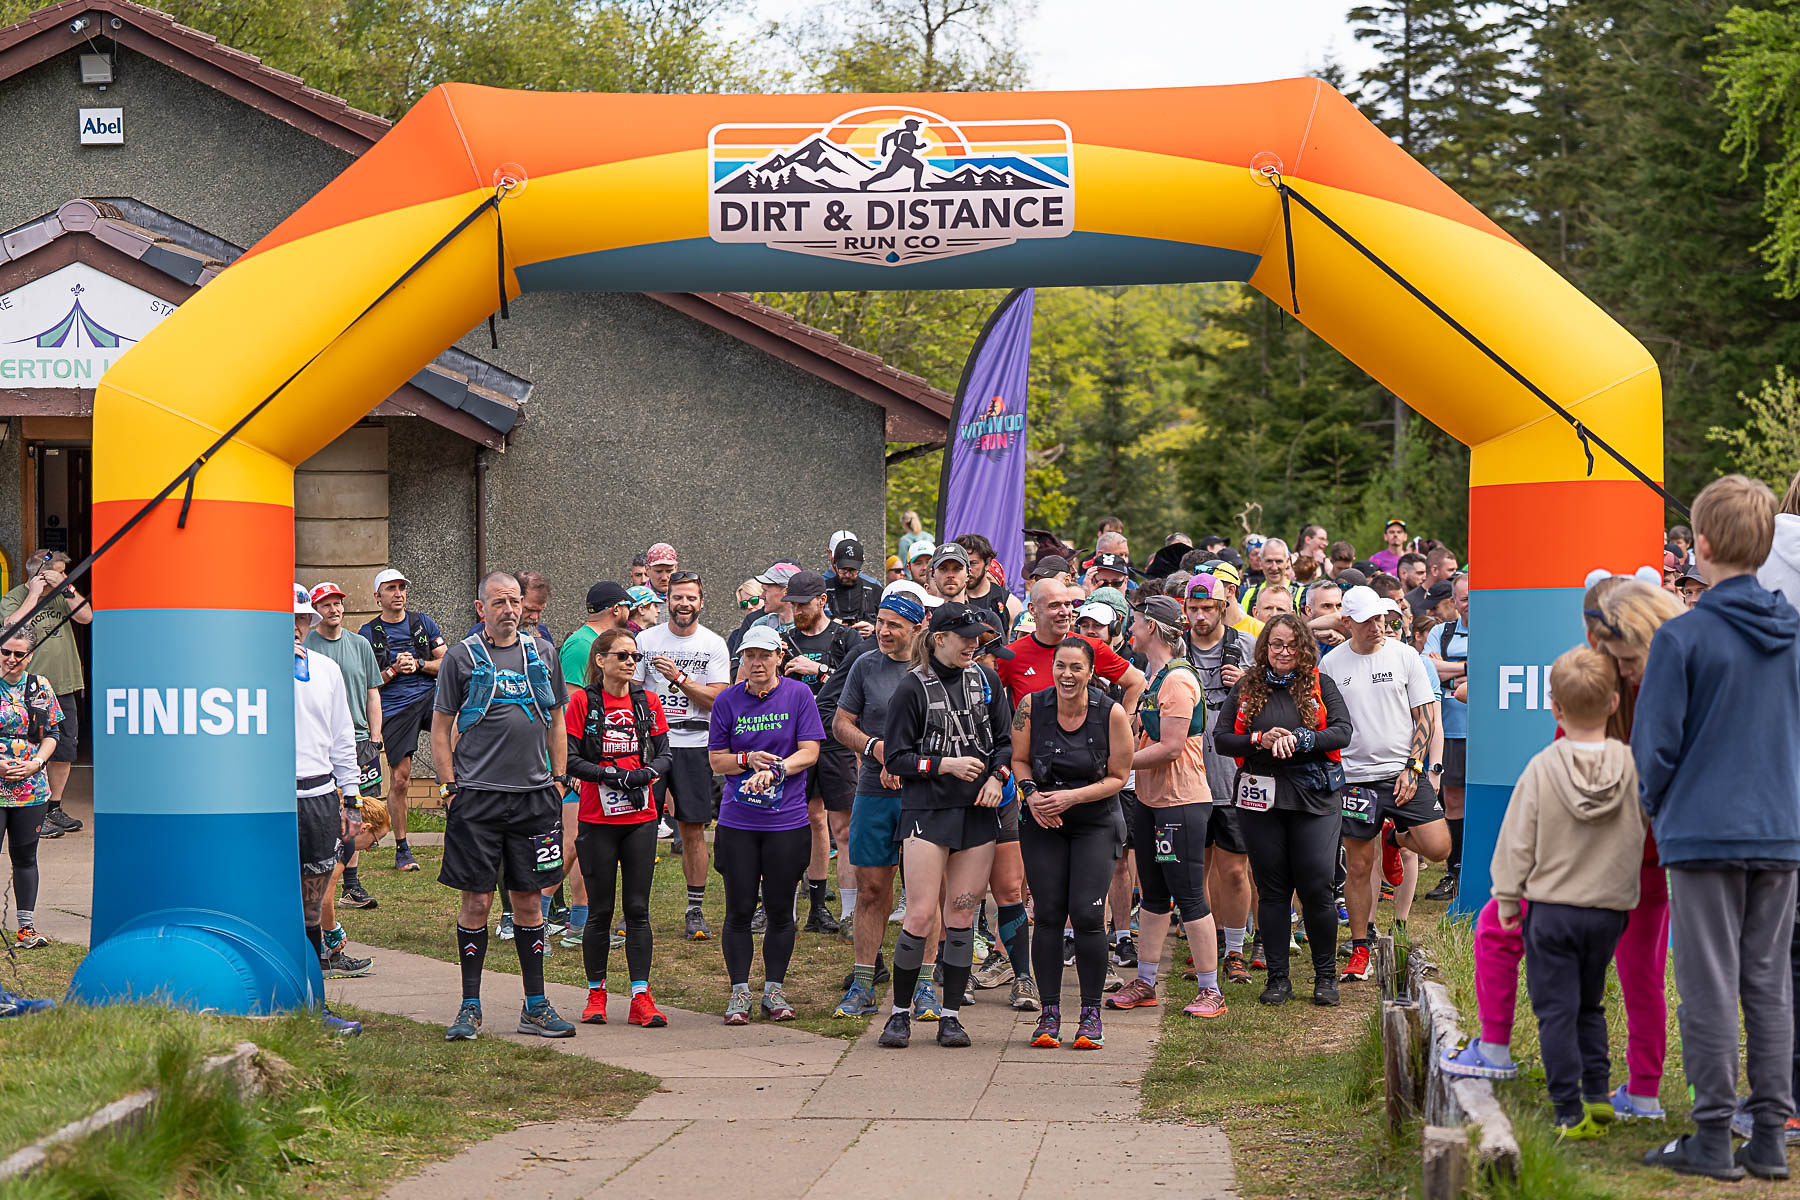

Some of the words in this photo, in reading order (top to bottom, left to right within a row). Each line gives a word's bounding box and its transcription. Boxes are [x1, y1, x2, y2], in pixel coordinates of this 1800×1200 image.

[82, 117, 121, 134] Abel
[720, 201, 811, 232] DIRT
[823, 201, 853, 231] &
[867, 196, 1064, 231] DISTANCE
[844, 236, 896, 250] RUN
[903, 235, 941, 249] CO
[981, 433, 1008, 450] RUN
[1371, 671, 1393, 680] UTMB
[1498, 665, 1552, 710] FI
[659, 694, 689, 708] 333
[106, 687, 268, 735] FINISH
[737, 712, 789, 724] Monkton
[738, 779, 777, 799] 24
[1241, 785, 1267, 801] 351
[1342, 795, 1370, 811] 157
[536, 844, 561, 863] 23
